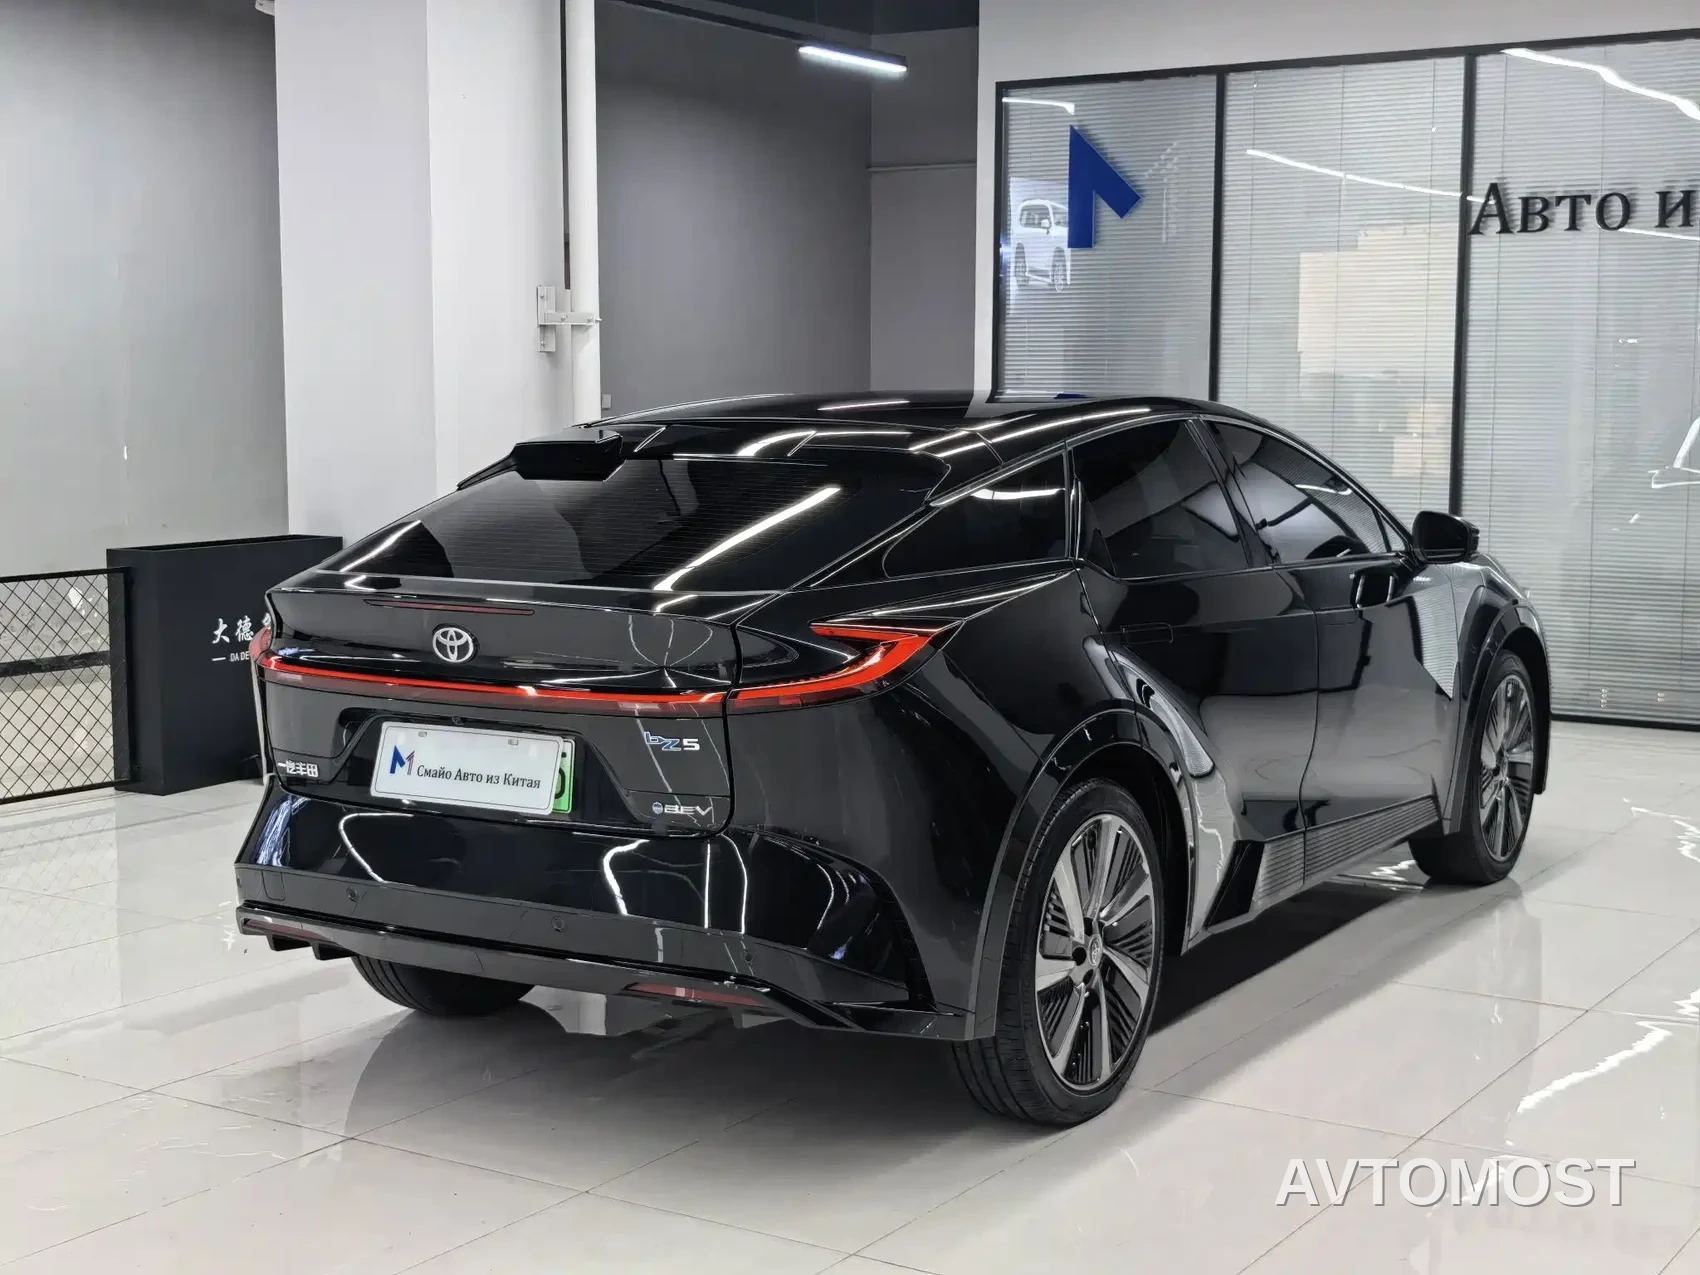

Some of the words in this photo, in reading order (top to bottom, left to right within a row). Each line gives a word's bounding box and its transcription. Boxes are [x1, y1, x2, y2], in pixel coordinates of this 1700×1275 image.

[1468, 182, 1631, 235] Авто
[211, 612, 272, 644] 大德
[416, 764, 452, 780] Смайо
[454, 768, 483, 783] Авто
[485, 773, 500, 785] из
[503, 773, 541, 789] Китая
[663, 804, 713, 816] BEV
